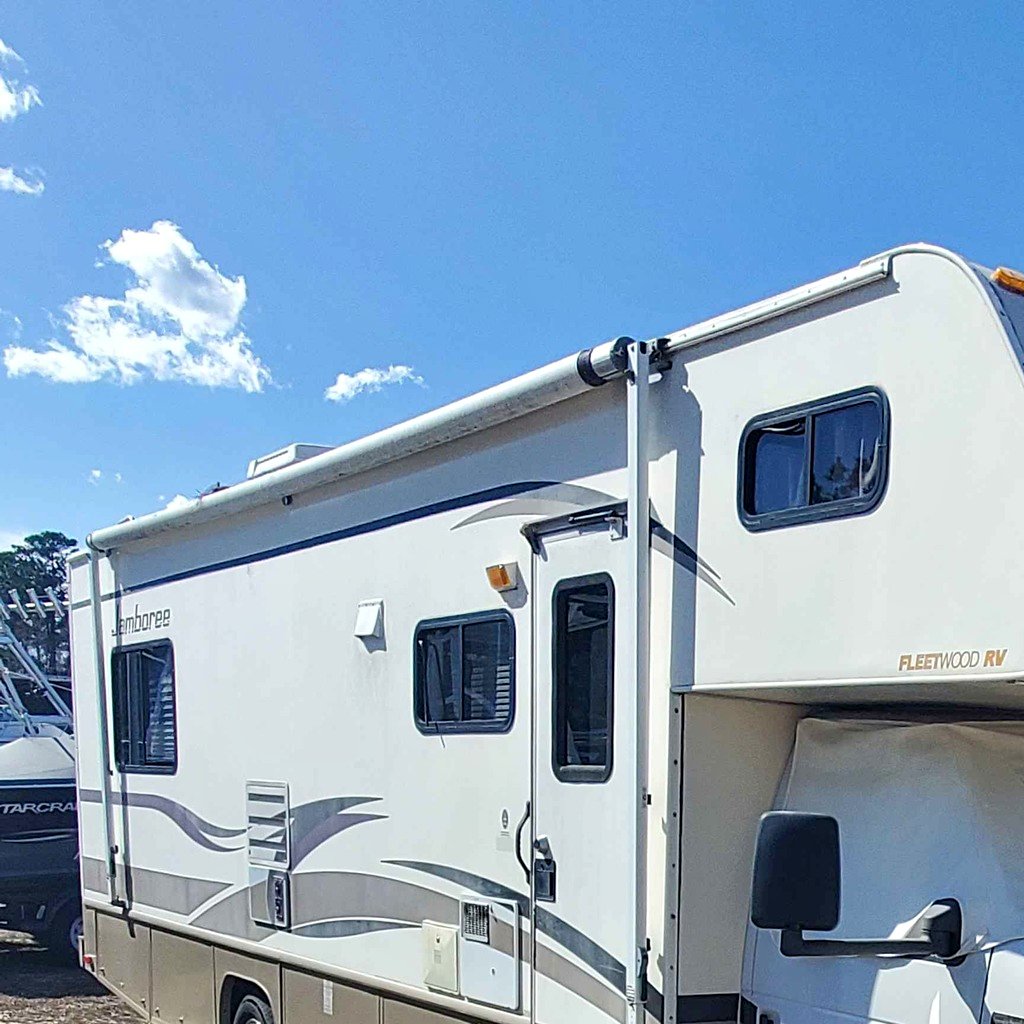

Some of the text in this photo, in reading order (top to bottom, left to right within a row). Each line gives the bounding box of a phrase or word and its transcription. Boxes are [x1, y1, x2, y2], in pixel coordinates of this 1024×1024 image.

[898, 648, 1008, 671] FLEETWOOD RV
[0, 802, 77, 814] TARCRA
